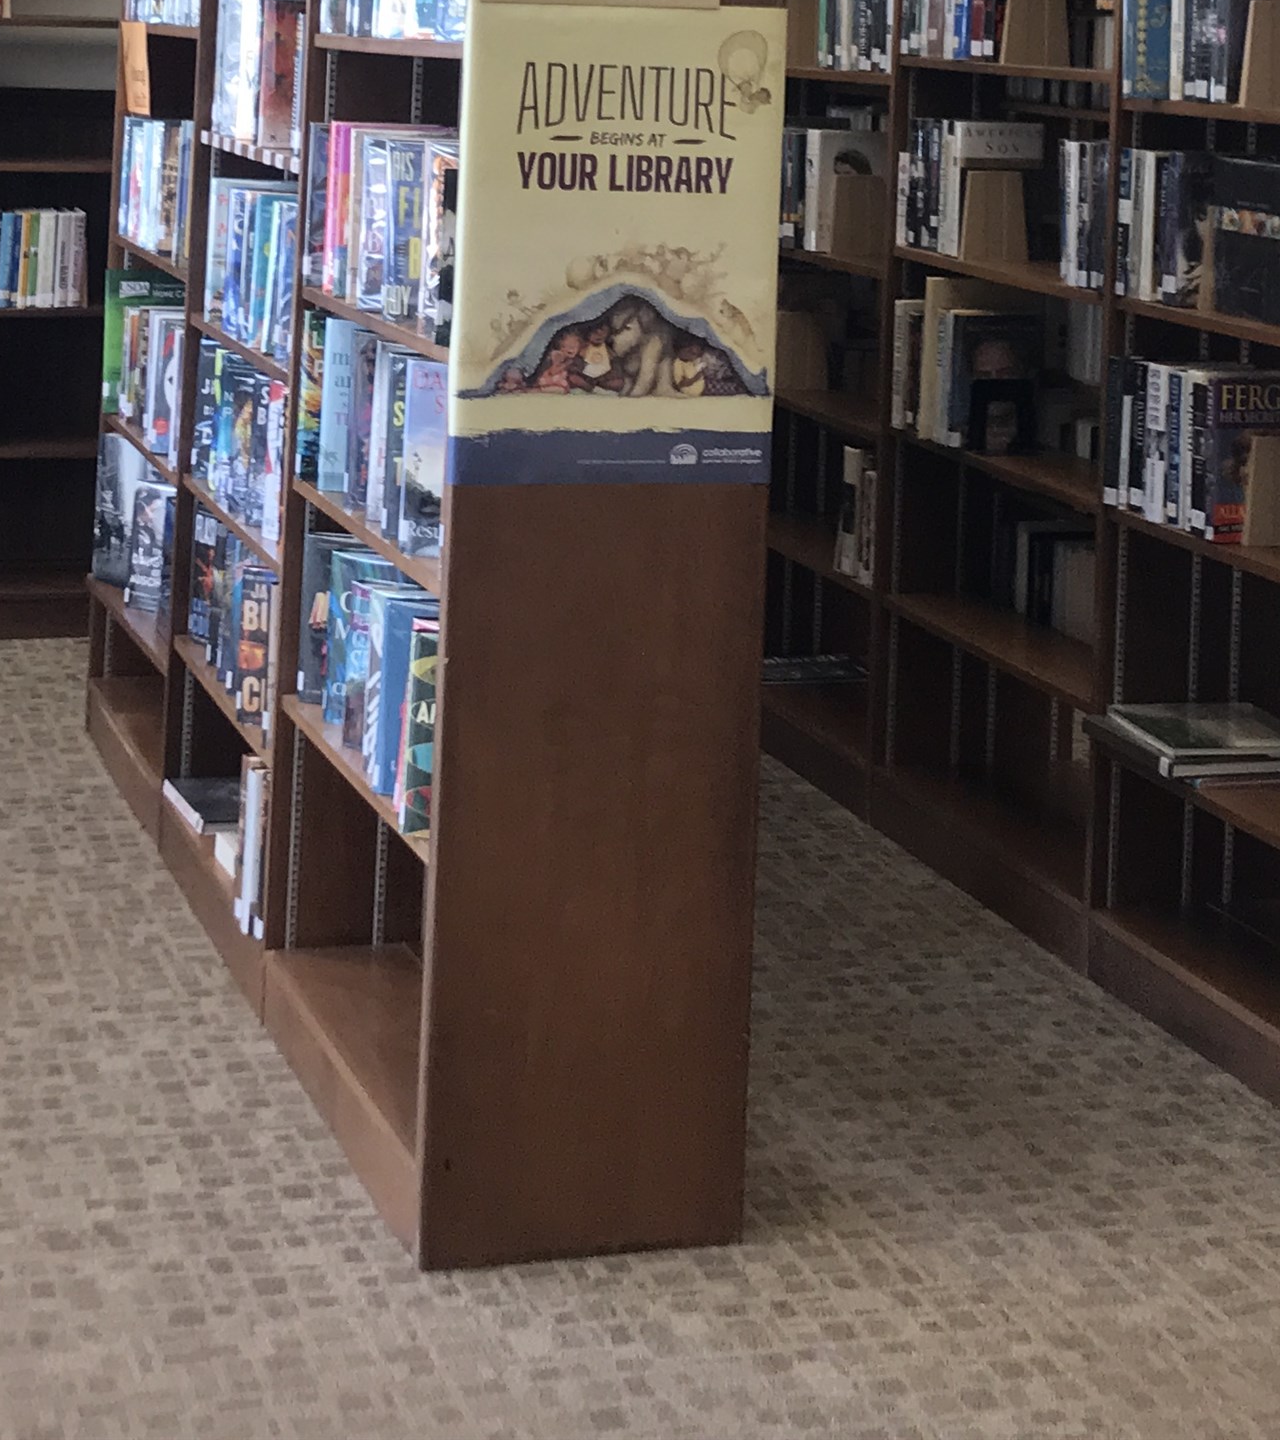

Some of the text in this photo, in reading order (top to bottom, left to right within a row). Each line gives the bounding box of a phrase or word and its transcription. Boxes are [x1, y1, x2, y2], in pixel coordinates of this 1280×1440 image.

[516, 61, 737, 141] ADVENTURE
[590, 131, 668, 147] BEGINS AT
[517, 151, 734, 194] YOUR LIBRARY
[701, 447, 763, 457] collaborative
